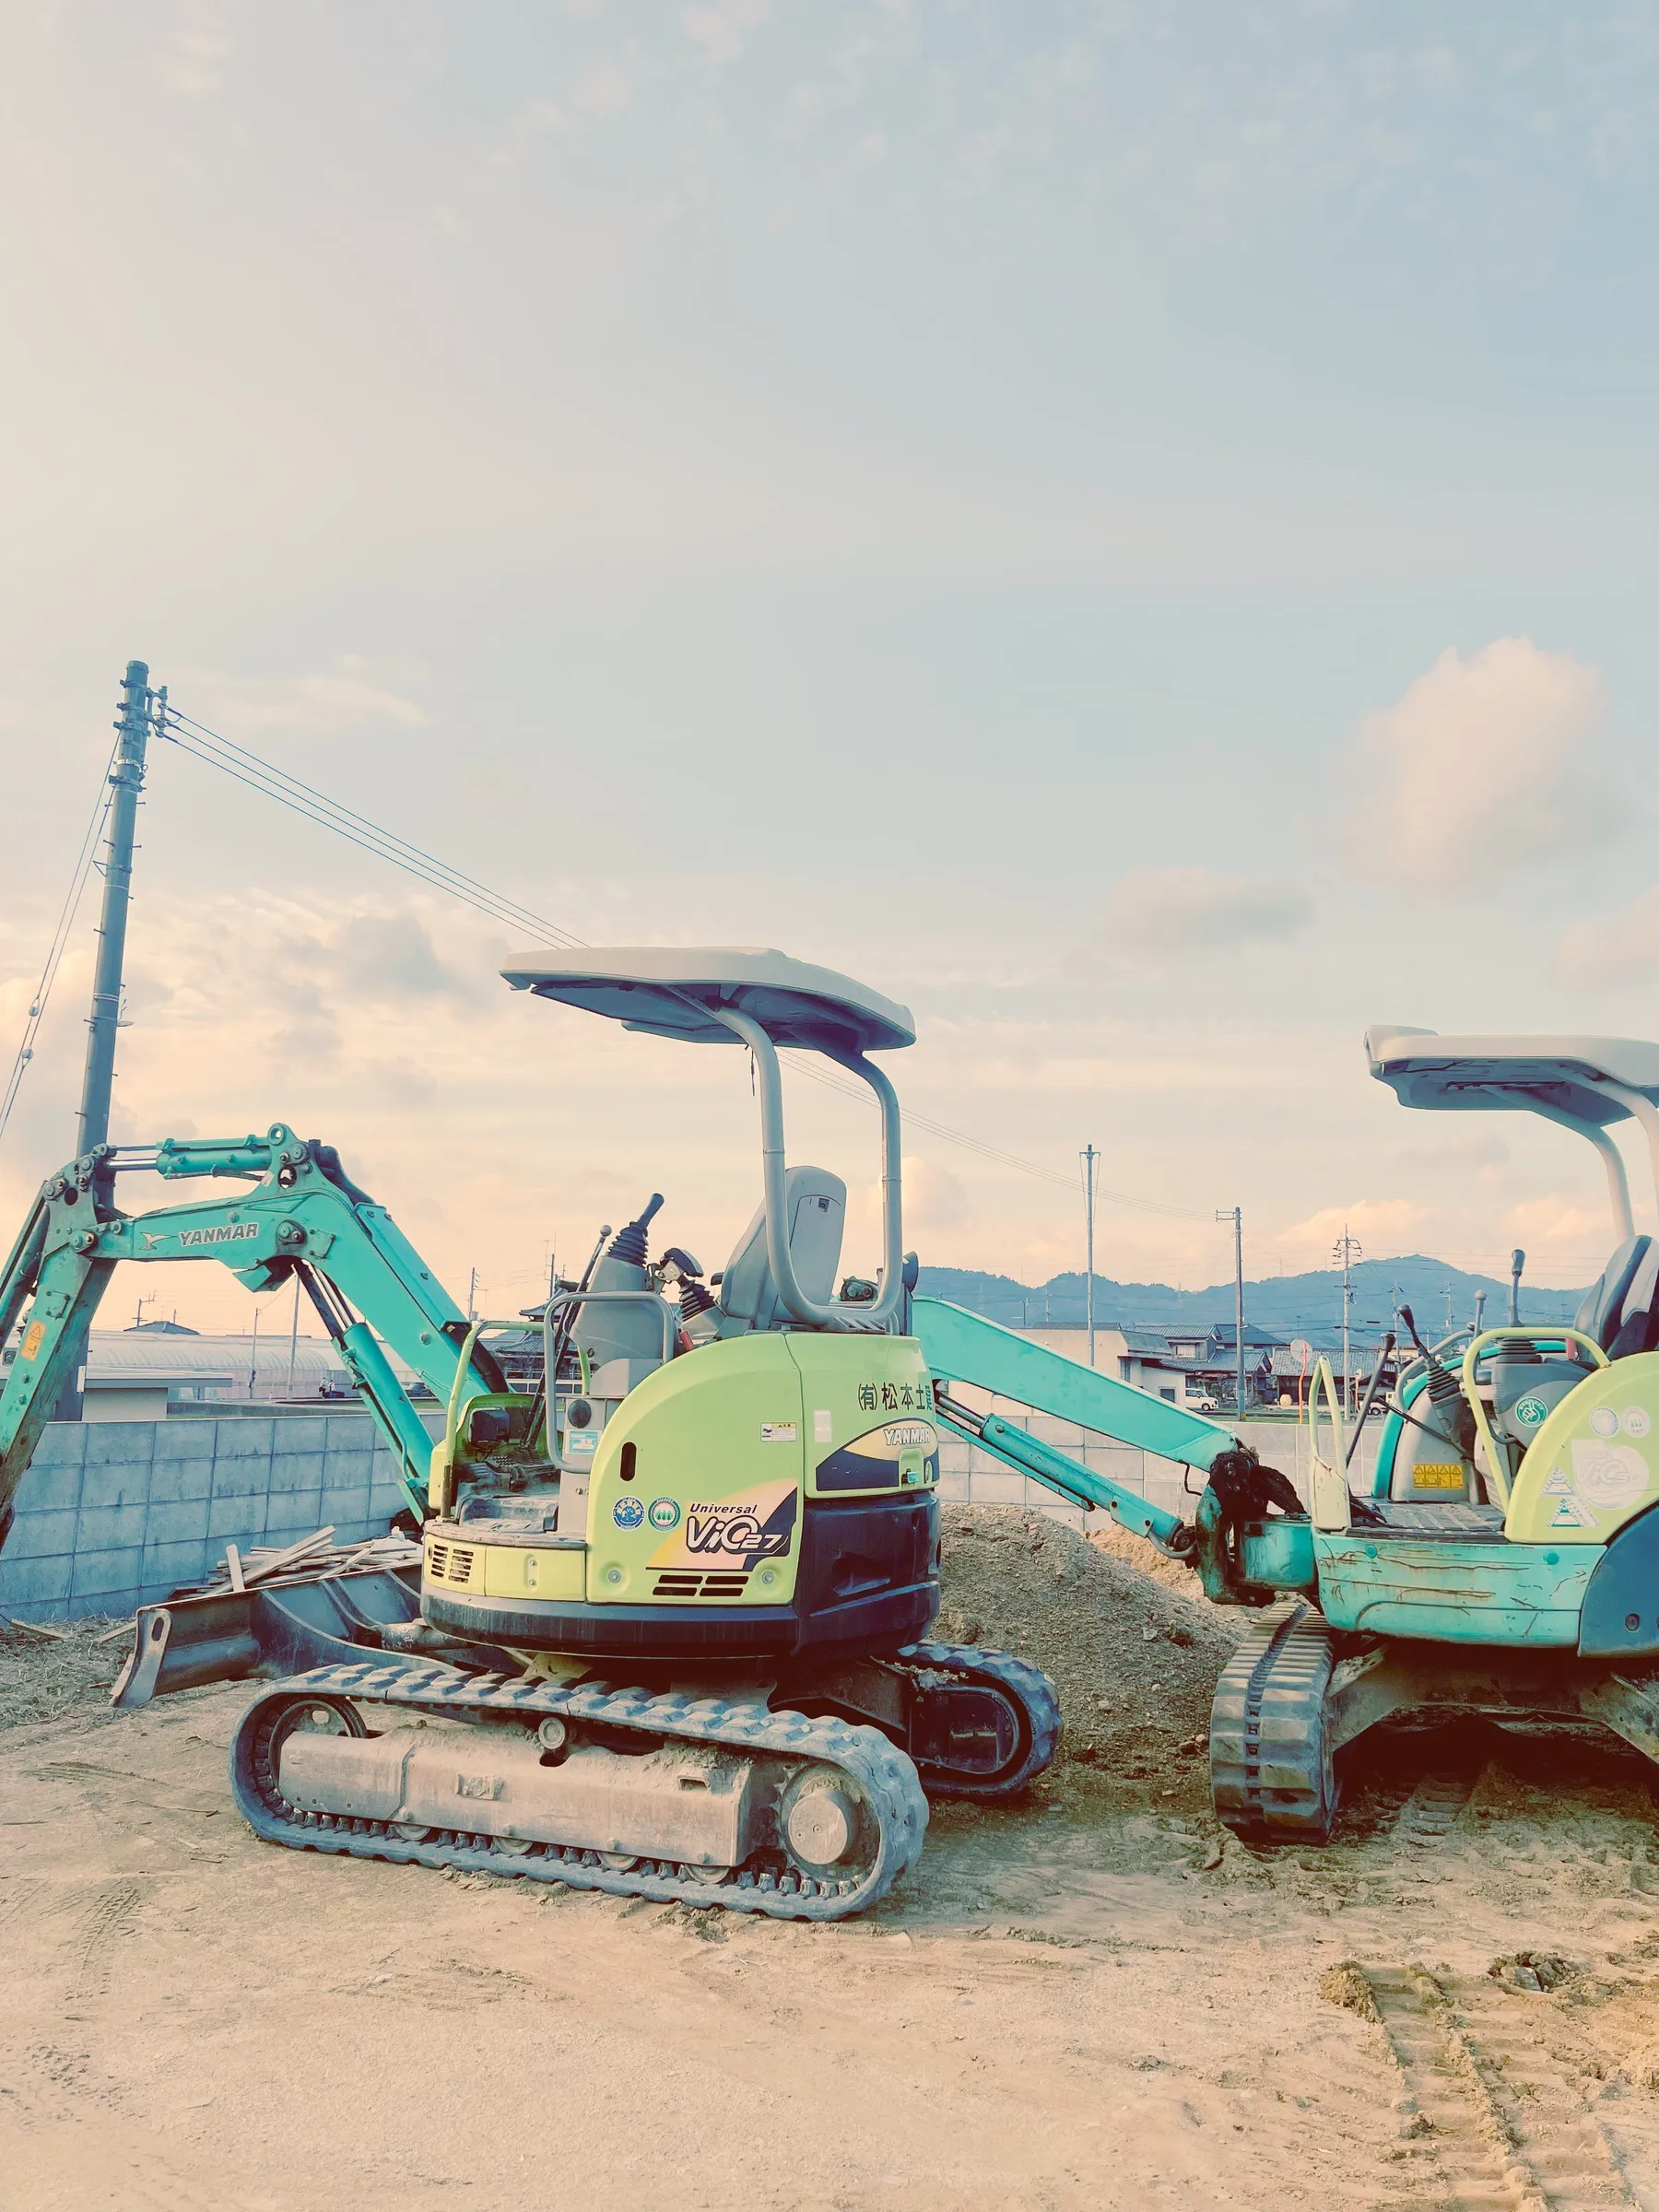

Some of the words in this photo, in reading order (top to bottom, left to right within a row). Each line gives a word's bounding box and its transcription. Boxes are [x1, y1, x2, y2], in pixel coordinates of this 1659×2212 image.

[179, 1222, 259, 1246] YANMAR
[883, 1427, 931, 1446] YANMAR
[689, 1503, 758, 1515] Universal
